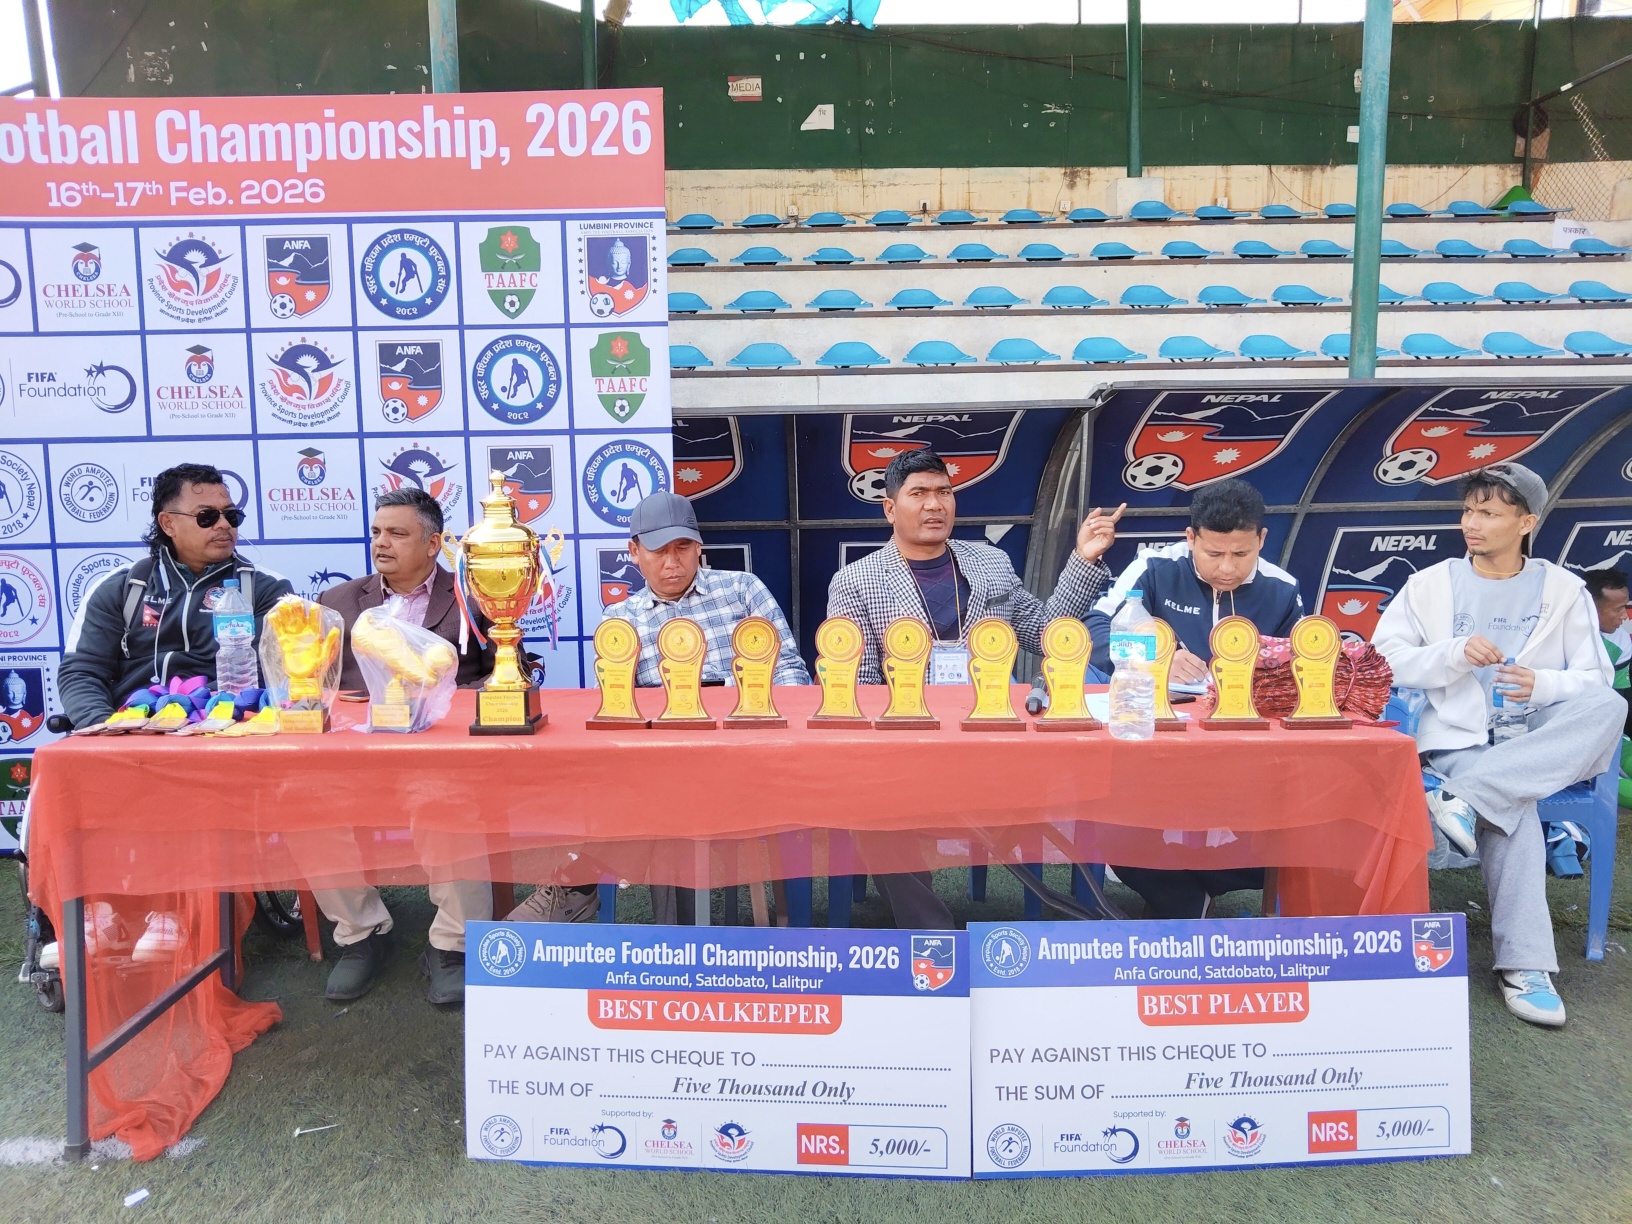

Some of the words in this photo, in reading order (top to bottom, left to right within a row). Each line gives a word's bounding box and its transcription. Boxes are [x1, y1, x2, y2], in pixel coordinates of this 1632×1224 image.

[731, 81, 761, 92] MEDIA
[155, 104, 511, 173] Championship,
[525, 100, 652, 157] 2026
[46, 180, 163, 207] 16th-17th
[169, 180, 234, 207] Feb.
[240, 178, 325, 205] 2026
[613, 221, 654, 229] PROVINCE
[1562, 226, 1587, 235] पत्रकार
[283, 240, 311, 250] ANFA
[381, 233, 401, 247] प्रदेश
[485, 272, 538, 289] TAAFC
[42, 283, 132, 298] CHELSEA
[147, 278, 165, 303] Province
[165, 300, 185, 314] Sports
[186, 298, 227, 316] Development
[224, 275, 239, 299] Council
[45, 299, 88, 309] WORLD
[89, 298, 134, 309] SCHOOL
[396, 346, 423, 355] ANFA
[492, 339, 513, 354] प्रदेश
[27, 372, 56, 383] FIFA
[594, 377, 648, 393] TAAFC
[19, 383, 106, 398] Foundation
[156, 385, 244, 400] CHELSEA
[1480, 389, 1564, 399] NEPAL
[157, 401, 199, 411] WORLD
[201, 400, 247, 410] SCHOOL
[259, 382, 277, 408] Province
[277, 405, 297, 419] Sports
[298, 401, 339, 420] Development
[337, 381, 351, 402] Council
[1201, 393, 1283, 404] NEPAL
[892, 414, 973, 424] NEPAL
[506, 450, 534, 460] ANFA
[602, 444, 622, 458] प्रदेश
[1, 455, 30, 482] Society
[26, 482, 37, 511] Nepal
[63, 468, 83, 488] WORLD
[86, 466, 114, 488] AMPUTEE
[268, 487, 356, 502] CHELSEA
[448, 484, 463, 508] Council
[63, 493, 86, 519] FOOTBALL
[89, 492, 116, 520] FEDERATION
[269, 502, 311, 512] WORLD
[314, 502, 358, 512] SCHOOL
[2, 519, 24, 535] 2018
[1370, 535, 1437, 552] NEPAL
[82, 558, 111, 574] Sports
[143, 595, 173, 604] ELME
[558, 586, 573, 609] Council
[1164, 598, 1200, 615] KELME
[1424, 921, 1441, 929] ANFA
[506, 931, 521, 947] Society
[990, 930, 1008, 940] Sports
[923, 939, 942, 947] ANFA
[1038, 937, 1123, 964] Amputee
[1128, 935, 1205, 959] Football
[1210, 932, 1349, 961] Championship,
[1353, 930, 1402, 954] 2026
[532, 939, 616, 967] Amputee
[621, 941, 696, 966] Football
[702, 943, 843, 973] Championship,
[848, 945, 900, 969] 2026
[1008, 966, 1021, 976] 2018
[1114, 966, 1146, 980] Anfa
[1148, 966, 1202, 981] Ground,
[1204, 964, 1277, 979] Satdobato,
[1280, 963, 1331, 979] Lalitpur
[605, 971, 637, 985] Anfa
[640, 972, 692, 988] Ground,
[695, 973, 769, 990] Satdobato,
[772, 975, 824, 992] Lalitpur
[1142, 994, 1202, 1016] BEST
[1208, 991, 1305, 1014] PLAYER
[598, 999, 658, 1021] BEST
[663, 1001, 832, 1025] GOALKEEPER
[484, 1044, 517, 1059] PAY
[523, 1046, 600, 1062] AGAINST
[606, 1048, 645, 1064] THIS
[650, 1049, 725, 1068] CHEQUE
[731, 1052, 756, 1067] TO
[990, 1048, 1025, 1064] PAY
[1031, 1046, 1111, 1063] AGAINST
[1117, 1045, 1157, 1061] THIS
[1162, 1044, 1236, 1062] CHEQUE
[1242, 1043, 1267, 1058] TO
[1184, 1072, 1223, 1090] Five
[1229, 1068, 1317, 1089] Thousand
[1321, 1067, 1363, 1089] Only
[488, 1080, 519, 1095] THE
[525, 1081, 564, 1097] SUM
[570, 1082, 594, 1098] OF
[672, 1077, 711, 1095] Five
[717, 1078, 807, 1098] Thousand
[811, 1080, 856, 1102] Only
[995, 1085, 1028, 1101] THE
[1034, 1085, 1075, 1101] SUM
[1081, 1084, 1105, 1099] OF
[601, 1109, 641, 1118] Supported
[643, 1110, 654, 1119] by:
[1113, 1110, 1154, 1119] Supported
[1155, 1109, 1166, 1119] by:
[550, 1127, 570, 1136] FIFA
[991, 1127, 1005, 1142] WORLD
[1007, 1126, 1027, 1142] AMPUTEE
[1060, 1133, 1081, 1142] FIFA
[1311, 1121, 1354, 1142] NRS.
[1376, 1119, 1434, 1140] 5,000/-
[543, 1135, 605, 1148] Foundation
[644, 1139, 693, 1150] CHELSEA
[801, 1134, 845, 1155] NRS.
[869, 1138, 931, 1157] 5,000/-
[1053, 1141, 1117, 1153] Foundation
[1157, 1139, 1206, 1149] CHELSEA
[1008, 1145, 1028, 1166] FEDERATION
[1183, 1147, 1208, 1155] SCHOOL
